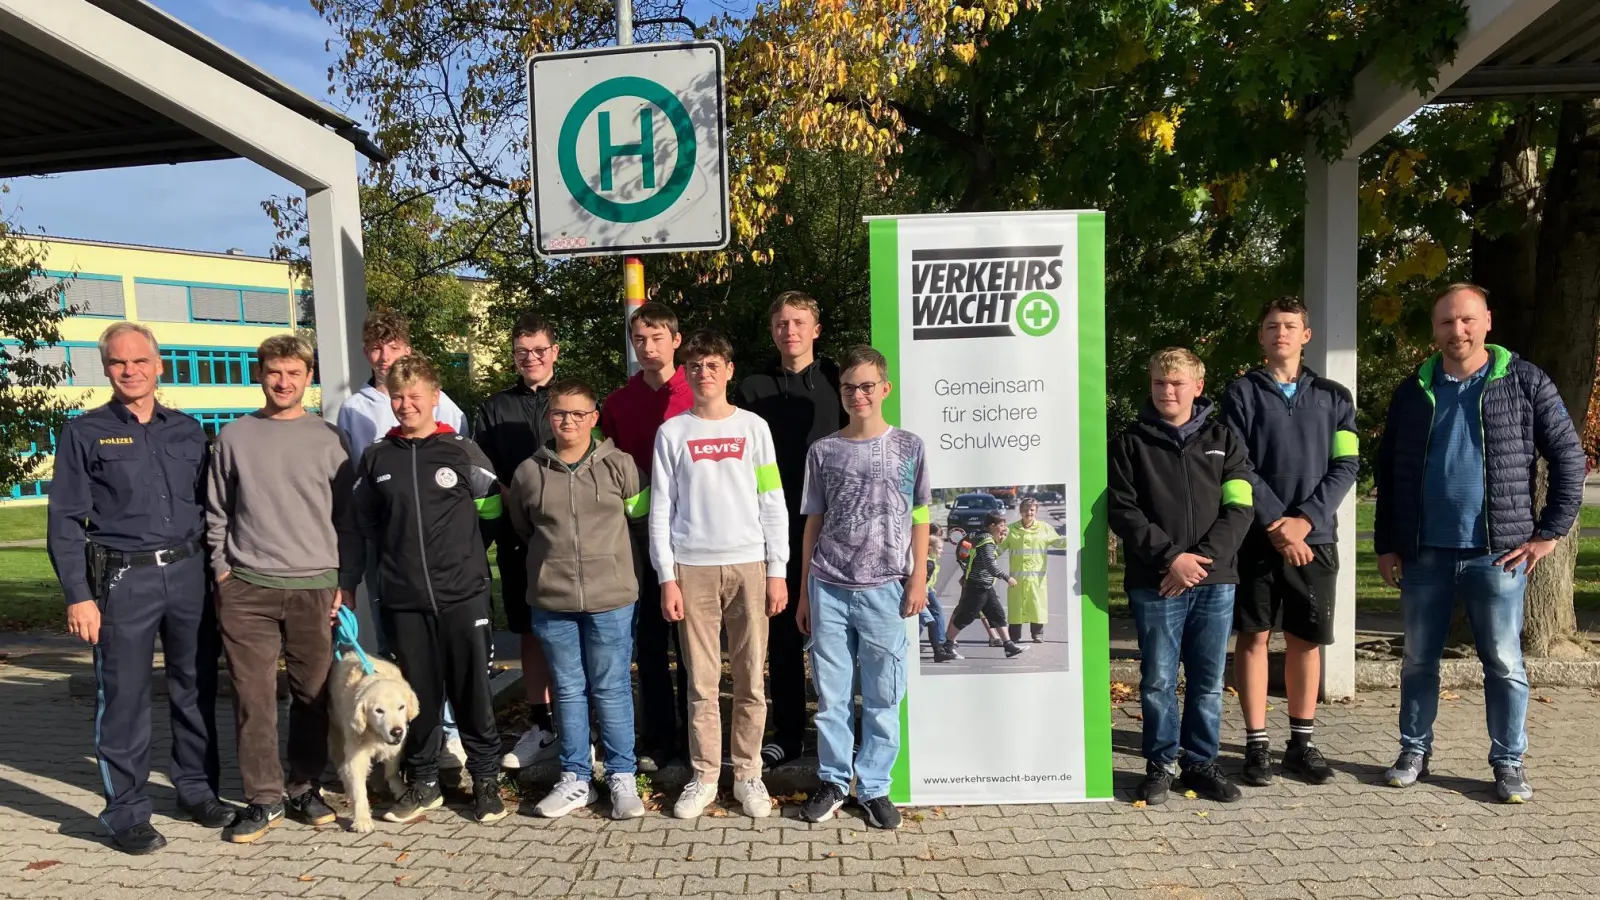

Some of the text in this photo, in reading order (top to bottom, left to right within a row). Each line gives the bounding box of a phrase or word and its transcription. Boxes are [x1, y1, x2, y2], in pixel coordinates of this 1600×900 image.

[597, 108, 656, 192] H
[912, 259, 1063, 294] VERKEHRS
[912, 292, 1018, 326] WACHT
[934, 377, 1044, 396] Gemeinsam
[942, 404, 1038, 423] für sichere
[100, 436, 134, 445] POLIZEI
[940, 432, 1041, 451] Schulwege
[923, 773, 1073, 784] www.verkehrswacht-bayern.de
